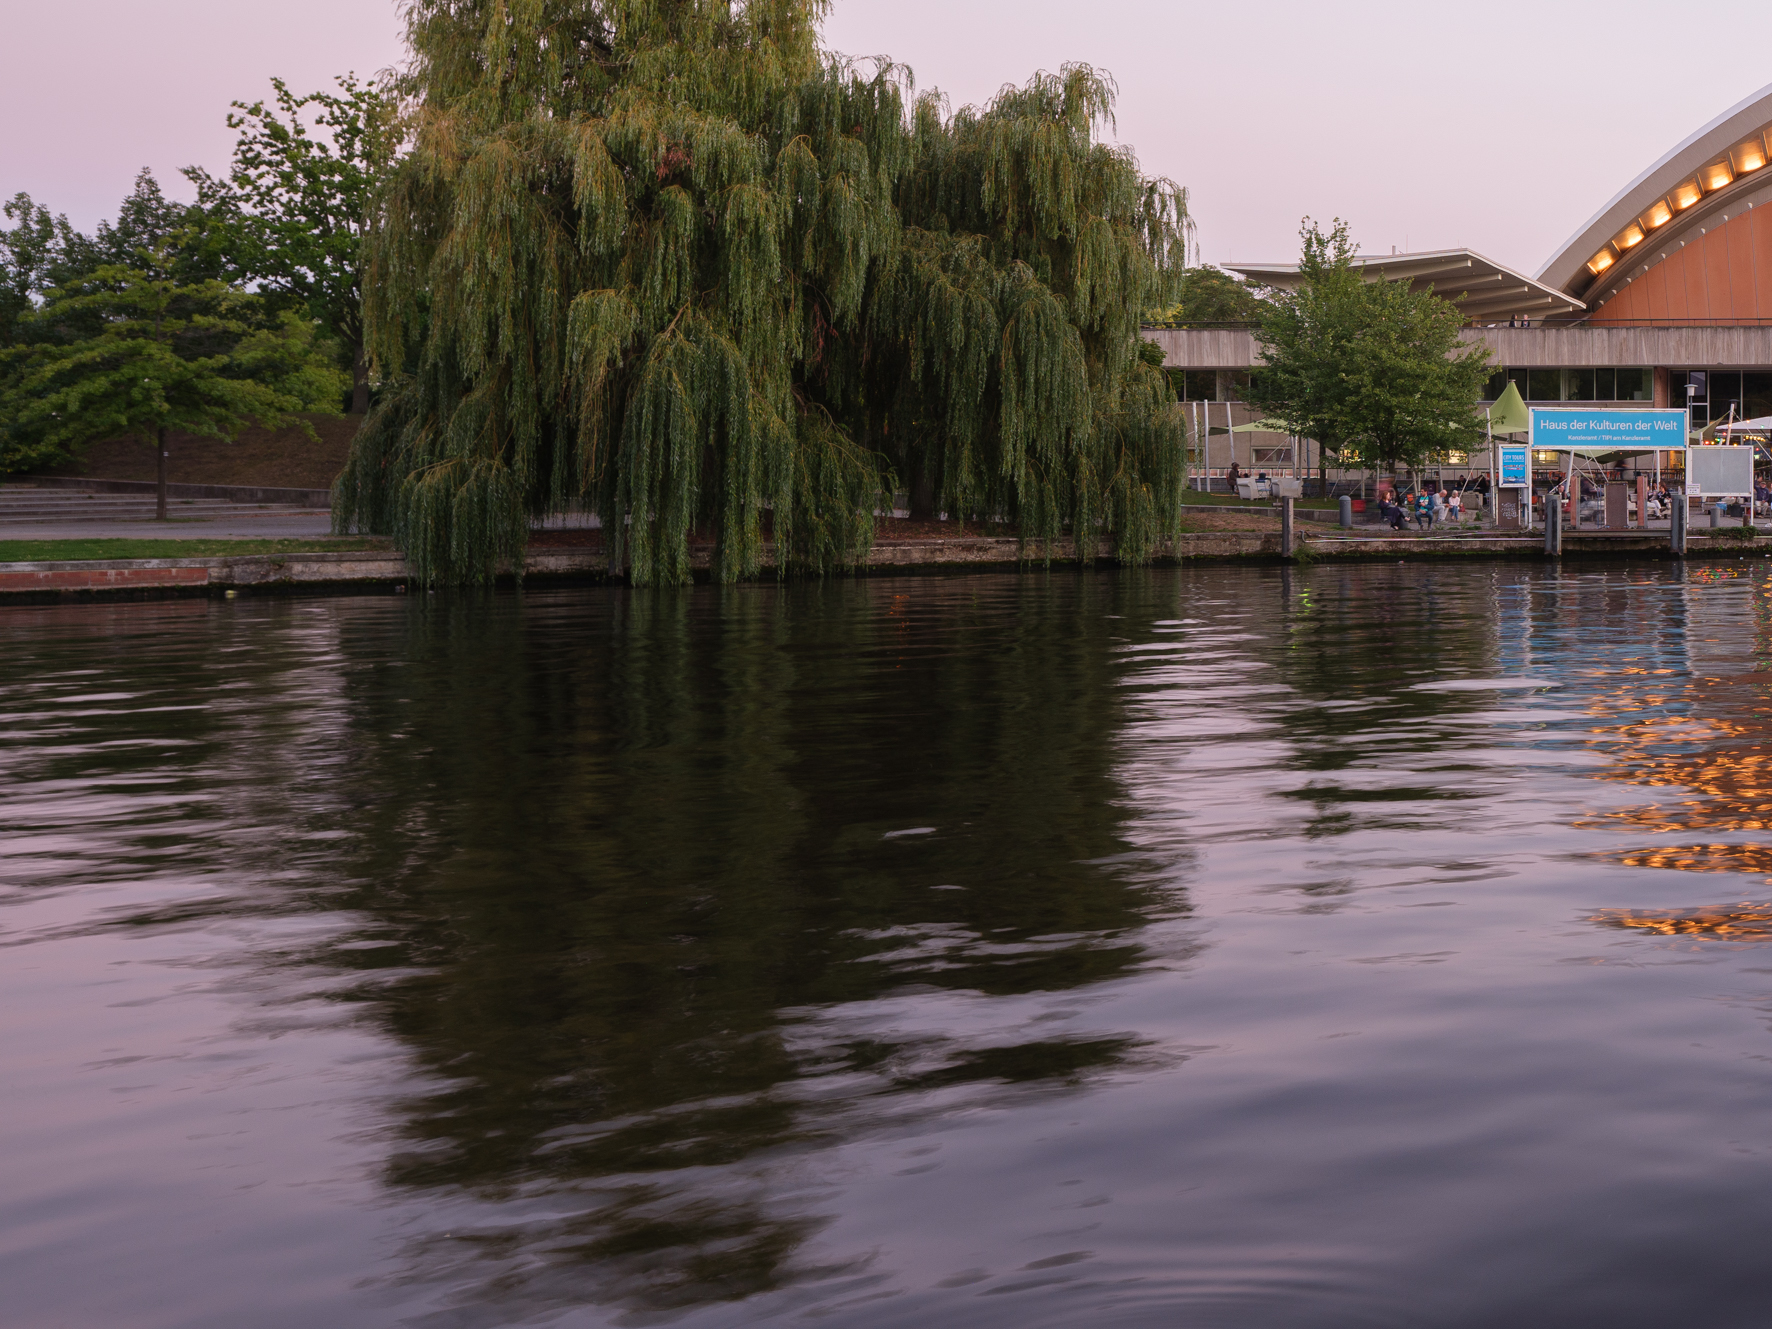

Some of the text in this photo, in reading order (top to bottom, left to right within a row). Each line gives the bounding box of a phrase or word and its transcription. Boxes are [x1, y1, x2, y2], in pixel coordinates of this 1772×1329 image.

[1540, 419, 1678, 431] Haus der Kulturen der Welt
